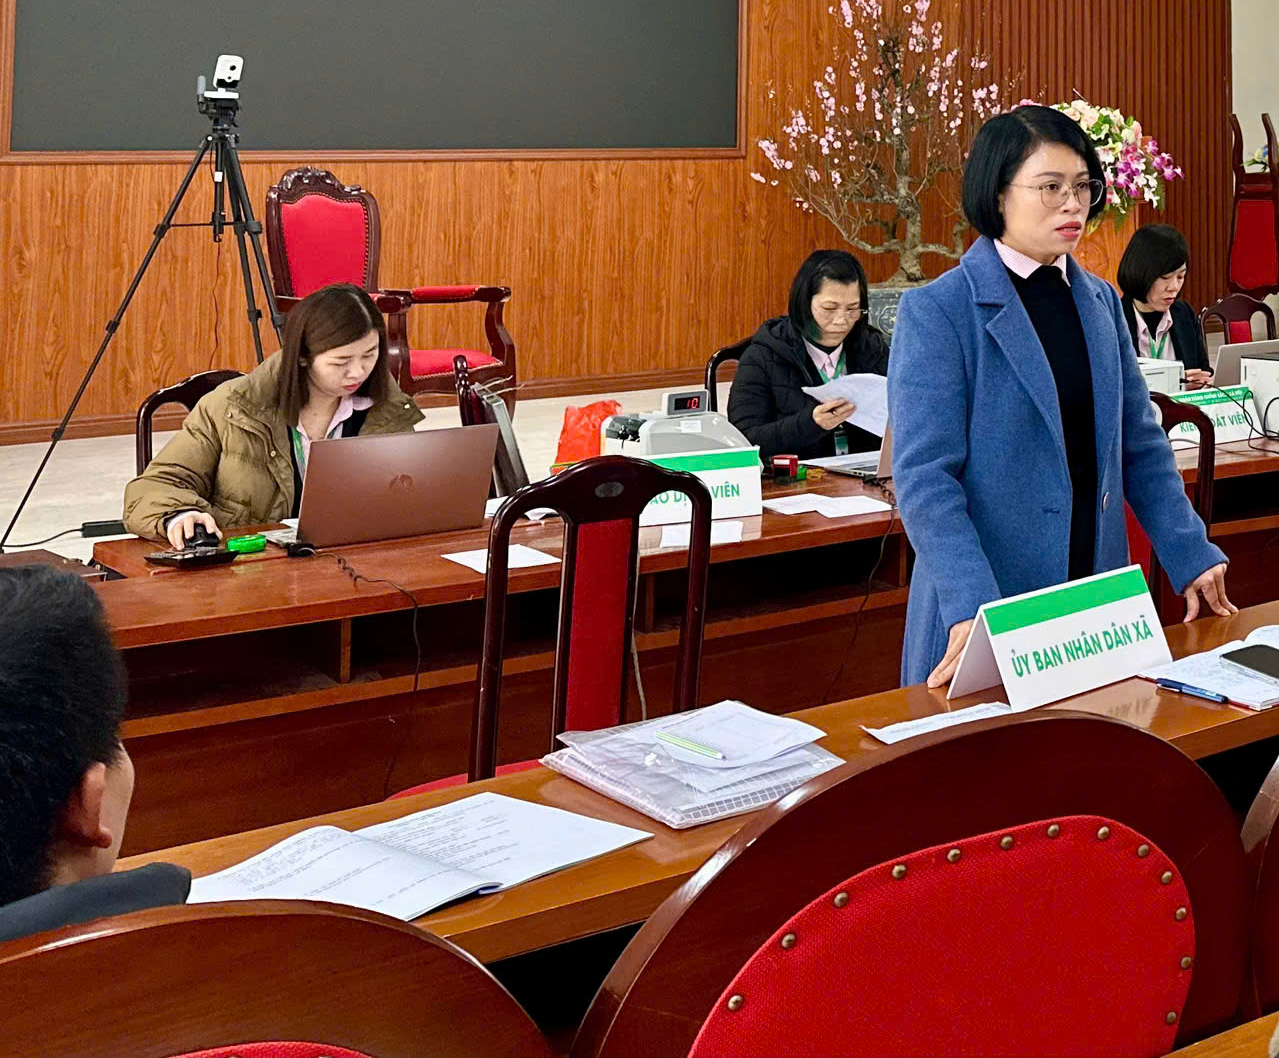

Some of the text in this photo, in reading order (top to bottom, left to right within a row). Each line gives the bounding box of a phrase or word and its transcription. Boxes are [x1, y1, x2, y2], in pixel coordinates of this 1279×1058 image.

[711, 481, 740, 498] VIÊN
[1011, 614, 1153, 677] ỦY BAN NHÂN DÂN XÃ
